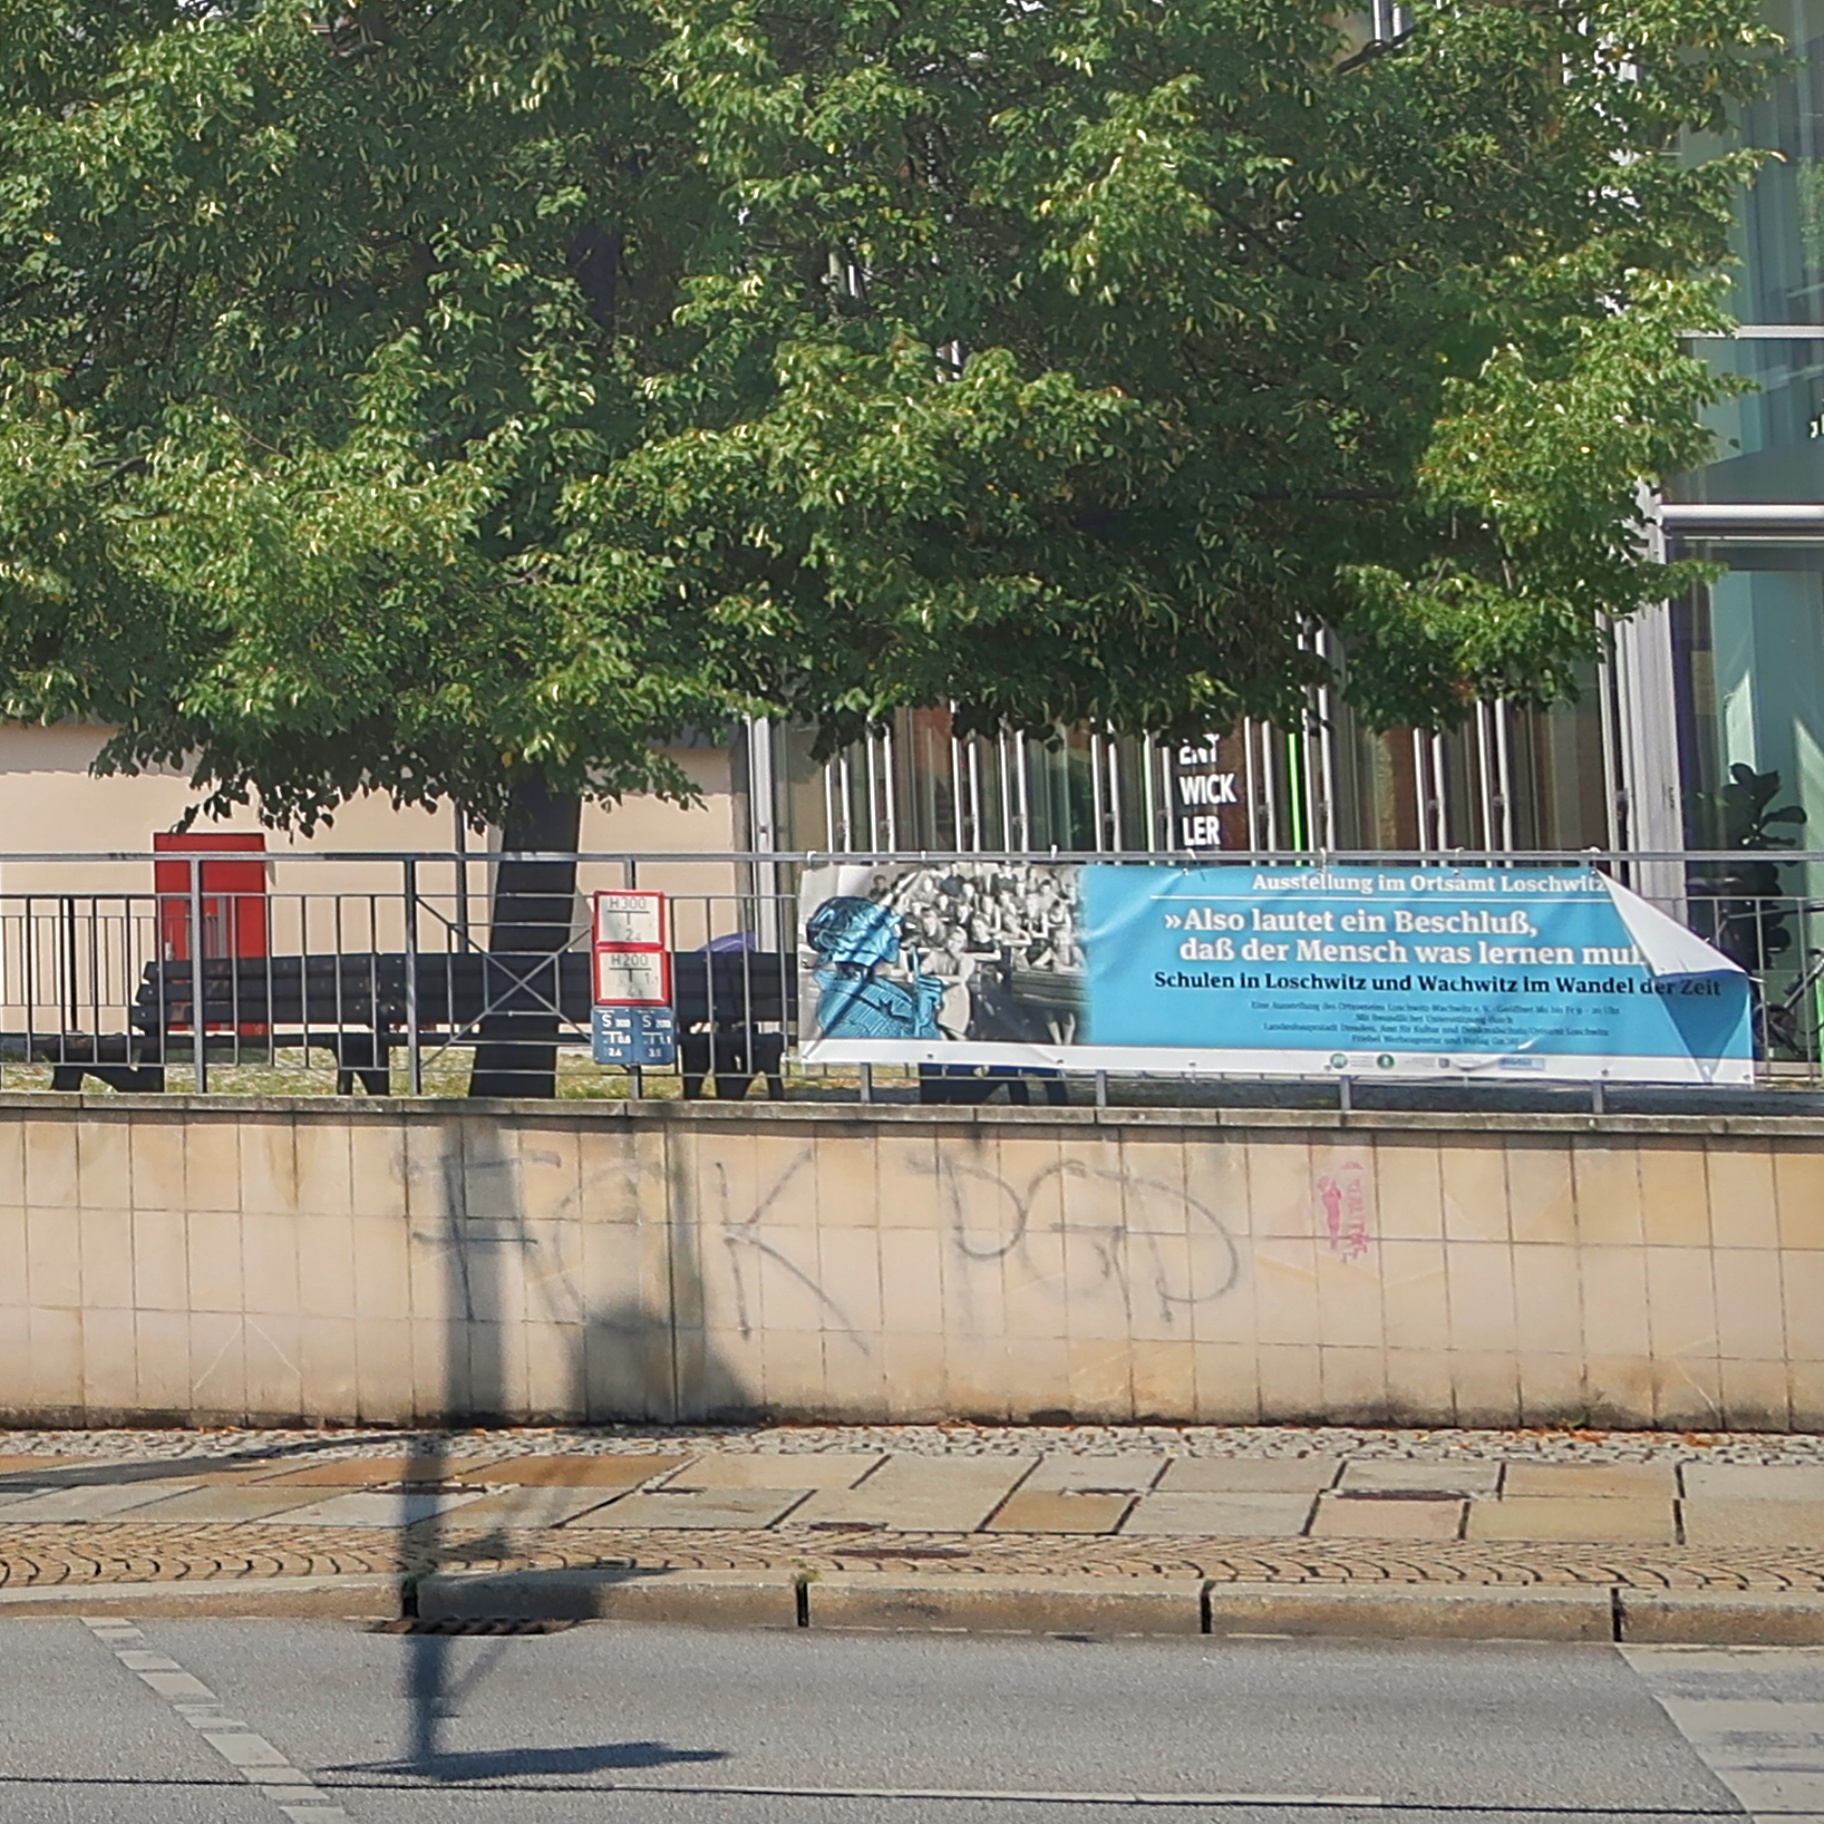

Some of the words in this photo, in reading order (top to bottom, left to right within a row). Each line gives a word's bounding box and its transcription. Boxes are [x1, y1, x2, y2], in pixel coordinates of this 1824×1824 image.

[1179, 773, 1237, 805] WICK
[1182, 815, 1220, 846] LER
[1252, 874, 1374, 895] Ausstellung
[1378, 874, 1406, 891] im
[1410, 874, 1496, 892] Ortsamt
[1502, 874, 1606, 892] Loschwitz
[610, 897, 646, 909] H300
[1164, 908, 1245, 932] »Also
[1252, 908, 1334, 932] lautet
[1340, 909, 1386, 933] ein
[1394, 910, 1538, 938] Beschluß,
[611, 954, 648, 966] H200
[1180, 937, 1235, 961] daß
[1241, 938, 1289, 962] der
[1296, 939, 1408, 963] Mensch
[1414, 945, 1472, 964] was
[1477, 941, 1576, 965] lernen
[1154, 971, 1235, 989] Schulen
[1240, 972, 1260, 989] in
[1265, 973, 1367, 991] Loschwitz
[1372, 973, 1412, 992] und
[1418, 976, 1518, 994] Wachwitz
[1523, 976, 1550, 993] im
[1555, 976, 1634, 994] Wandel
[1640, 978, 1674, 995] der
[1681, 979, 1722, 996] Zeit
[602, 1014, 612, 1027] S
[642, 1014, 651, 1027] S
